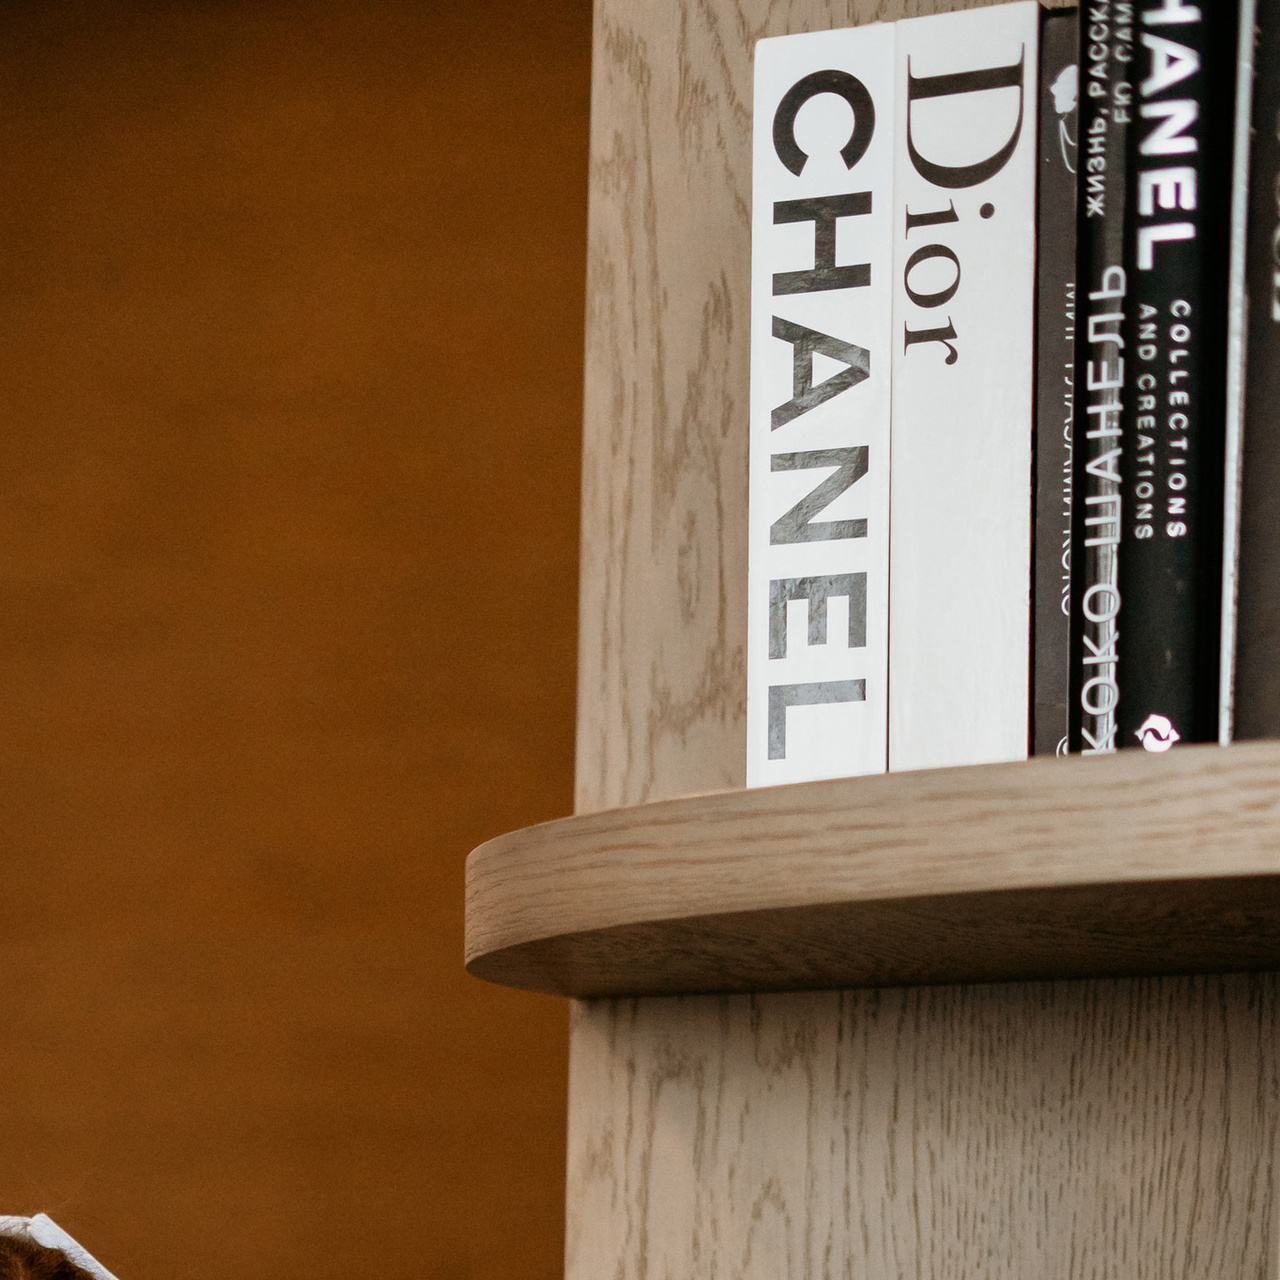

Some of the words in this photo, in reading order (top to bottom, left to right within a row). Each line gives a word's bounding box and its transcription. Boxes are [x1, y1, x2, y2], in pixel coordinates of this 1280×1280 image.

[1087, 0, 1110, 97] РАССК
[903, 42, 1026, 366] Dior
[1086, 107, 1111, 218] ЖИЗНЬ,
[767, 69, 875, 761] CHANEL
[1084, 265, 1127, 547] ШАНЕЛЬ
[1137, 303, 1158, 361] AND
[1166, 299, 1191, 538] COLLECTIONS
[1134, 373, 1157, 540] CREATIONS
[1081, 583, 1121, 756] КОКО
